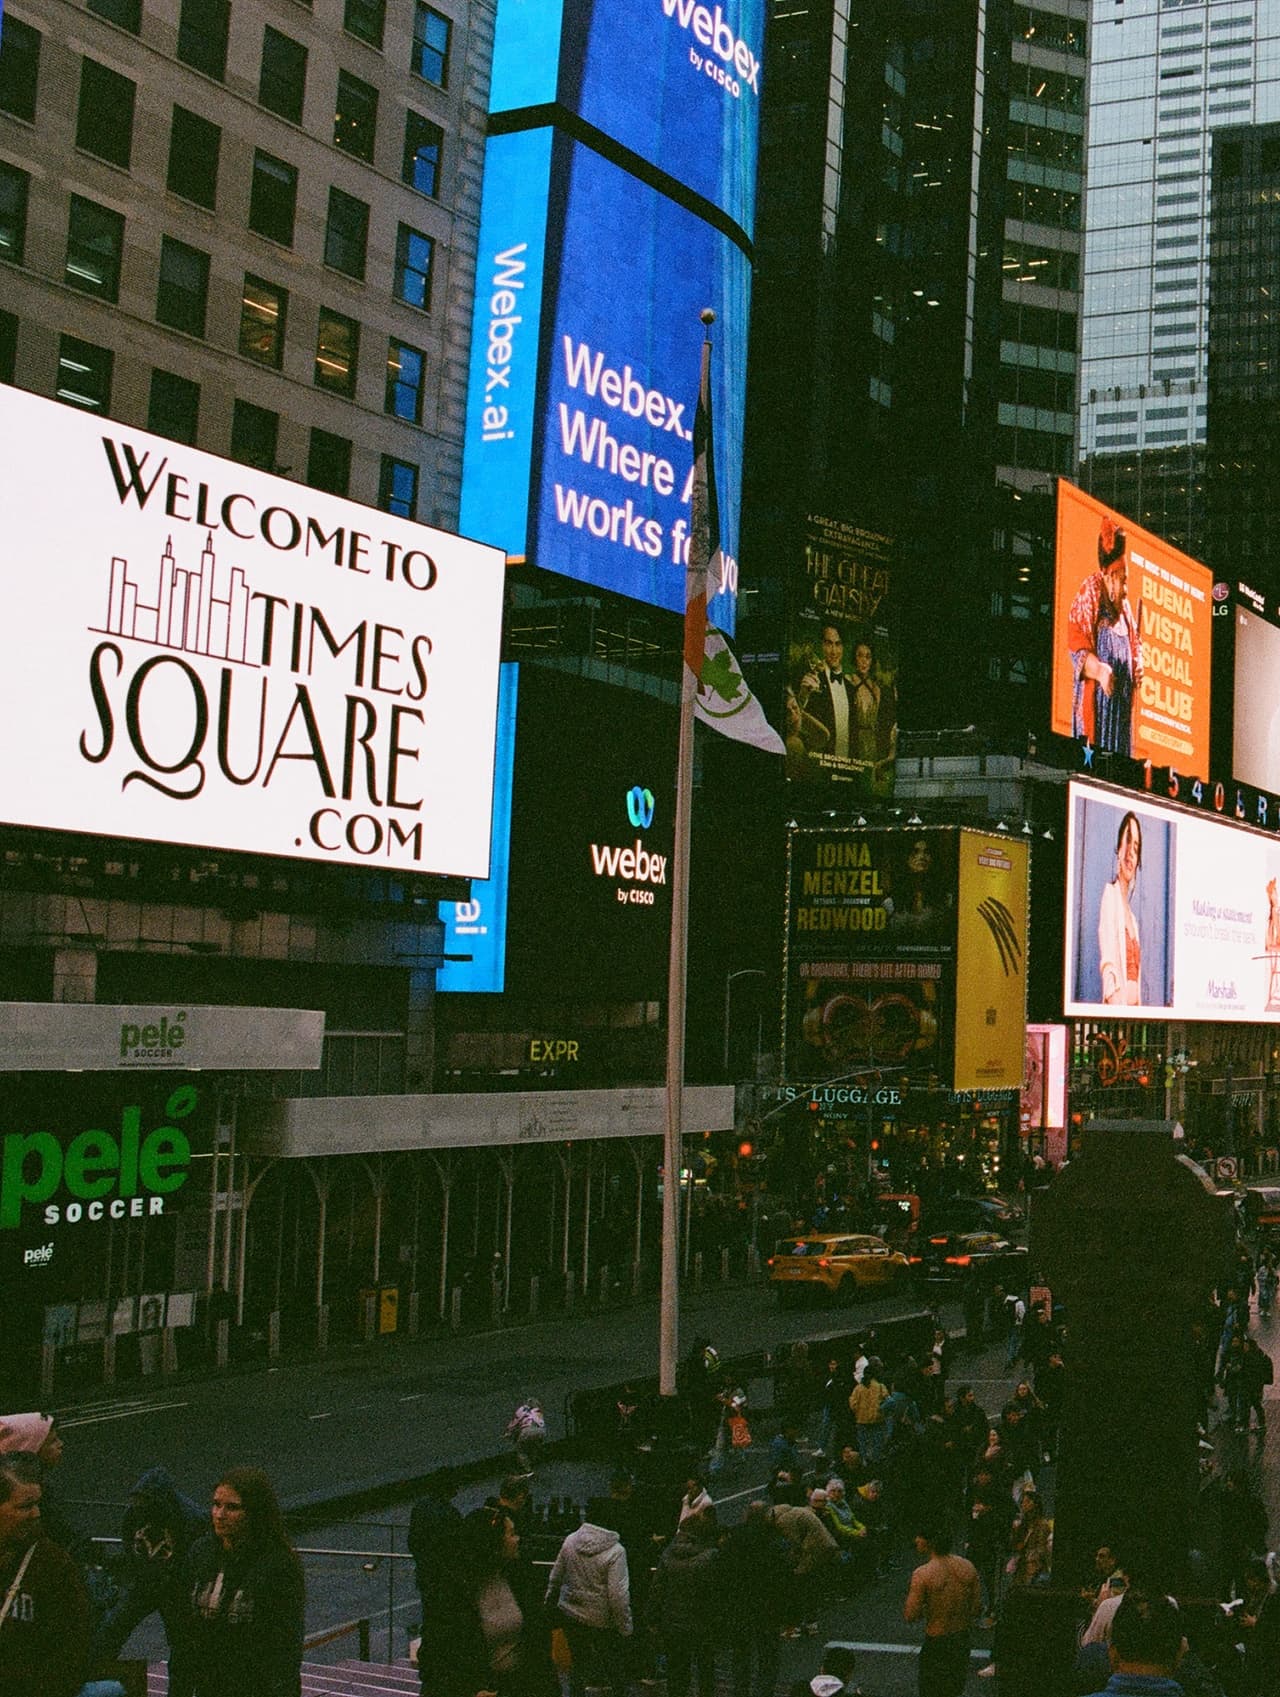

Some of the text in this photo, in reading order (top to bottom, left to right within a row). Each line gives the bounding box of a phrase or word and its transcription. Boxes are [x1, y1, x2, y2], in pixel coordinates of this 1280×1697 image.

[689, 47, 704, 73] by
[481, 242, 527, 441] Webex.ai
[563, 335, 692, 441] Webex.
[559, 402, 675, 496] Where
[101, 436, 439, 591] WELCOME TO
[555, 483, 663, 558] works
[1142, 575, 1194, 624] BUENA
[1212, 604, 1229, 617] LG
[250, 590, 433, 701] TIMES
[1141, 604, 1193, 657] VISTA
[1141, 641, 1193, 688] SOCIAL
[1140, 676, 1194, 722] CLUB
[79, 640, 426, 812] SQUARE
[294, 807, 424, 862] .COM
[816, 842, 872, 868] IDINA
[591, 839, 667, 885] webex
[803, 870, 884, 896] MENZEL
[617, 887, 629, 905] by
[797, 906, 887, 931] REDWOOD
[120, 1010, 186, 1057] pelé
[134, 1048, 173, 1058] SOCCER
[530, 1040, 579, 1062] EXPR
[0, 1084, 198, 1229] pelé
[44, 1196, 165, 1226] SOCCER
[24, 1242, 54, 1264] pelé
